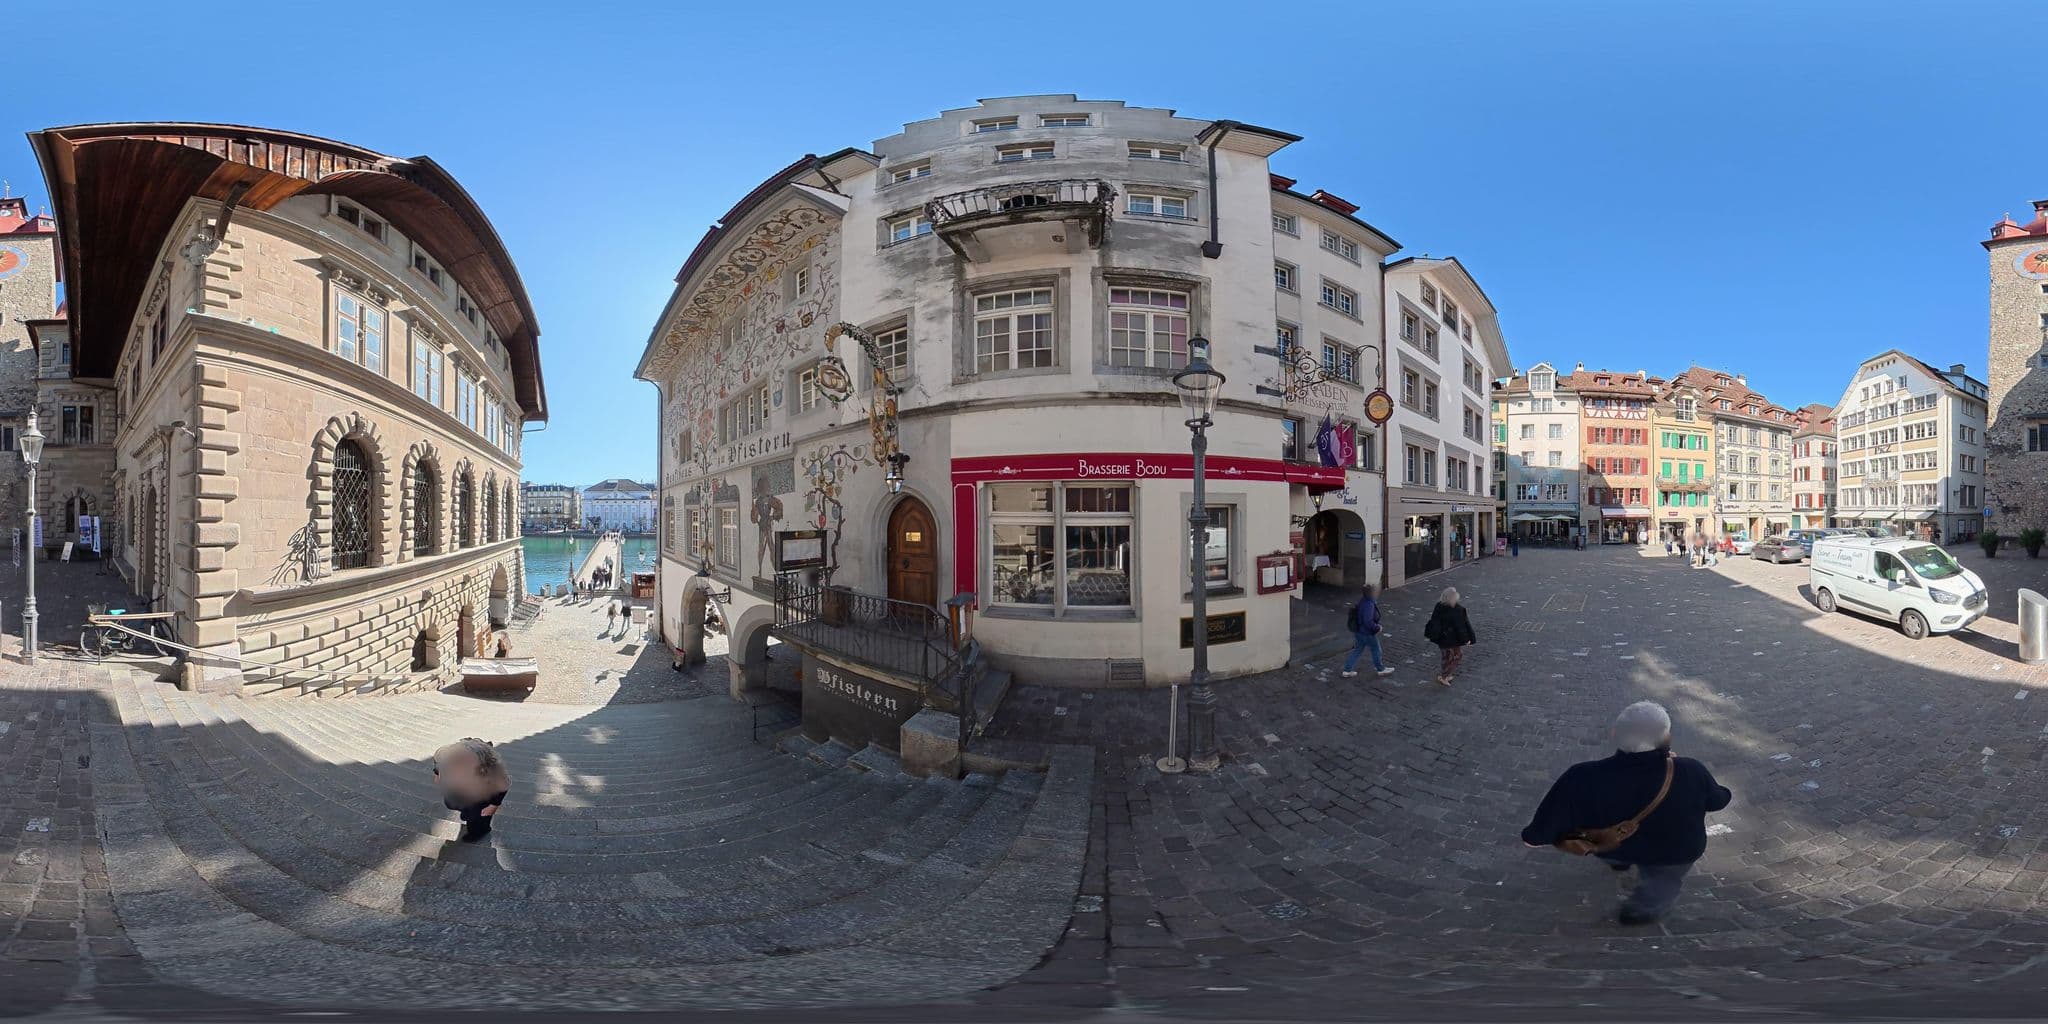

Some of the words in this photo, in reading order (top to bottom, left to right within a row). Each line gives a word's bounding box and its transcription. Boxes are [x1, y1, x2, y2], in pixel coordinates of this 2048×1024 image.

[1078, 459, 1130, 477] BRASSERIE
[1136, 459, 1167, 477] BODU
[816, 666, 897, 711] Pfistern
